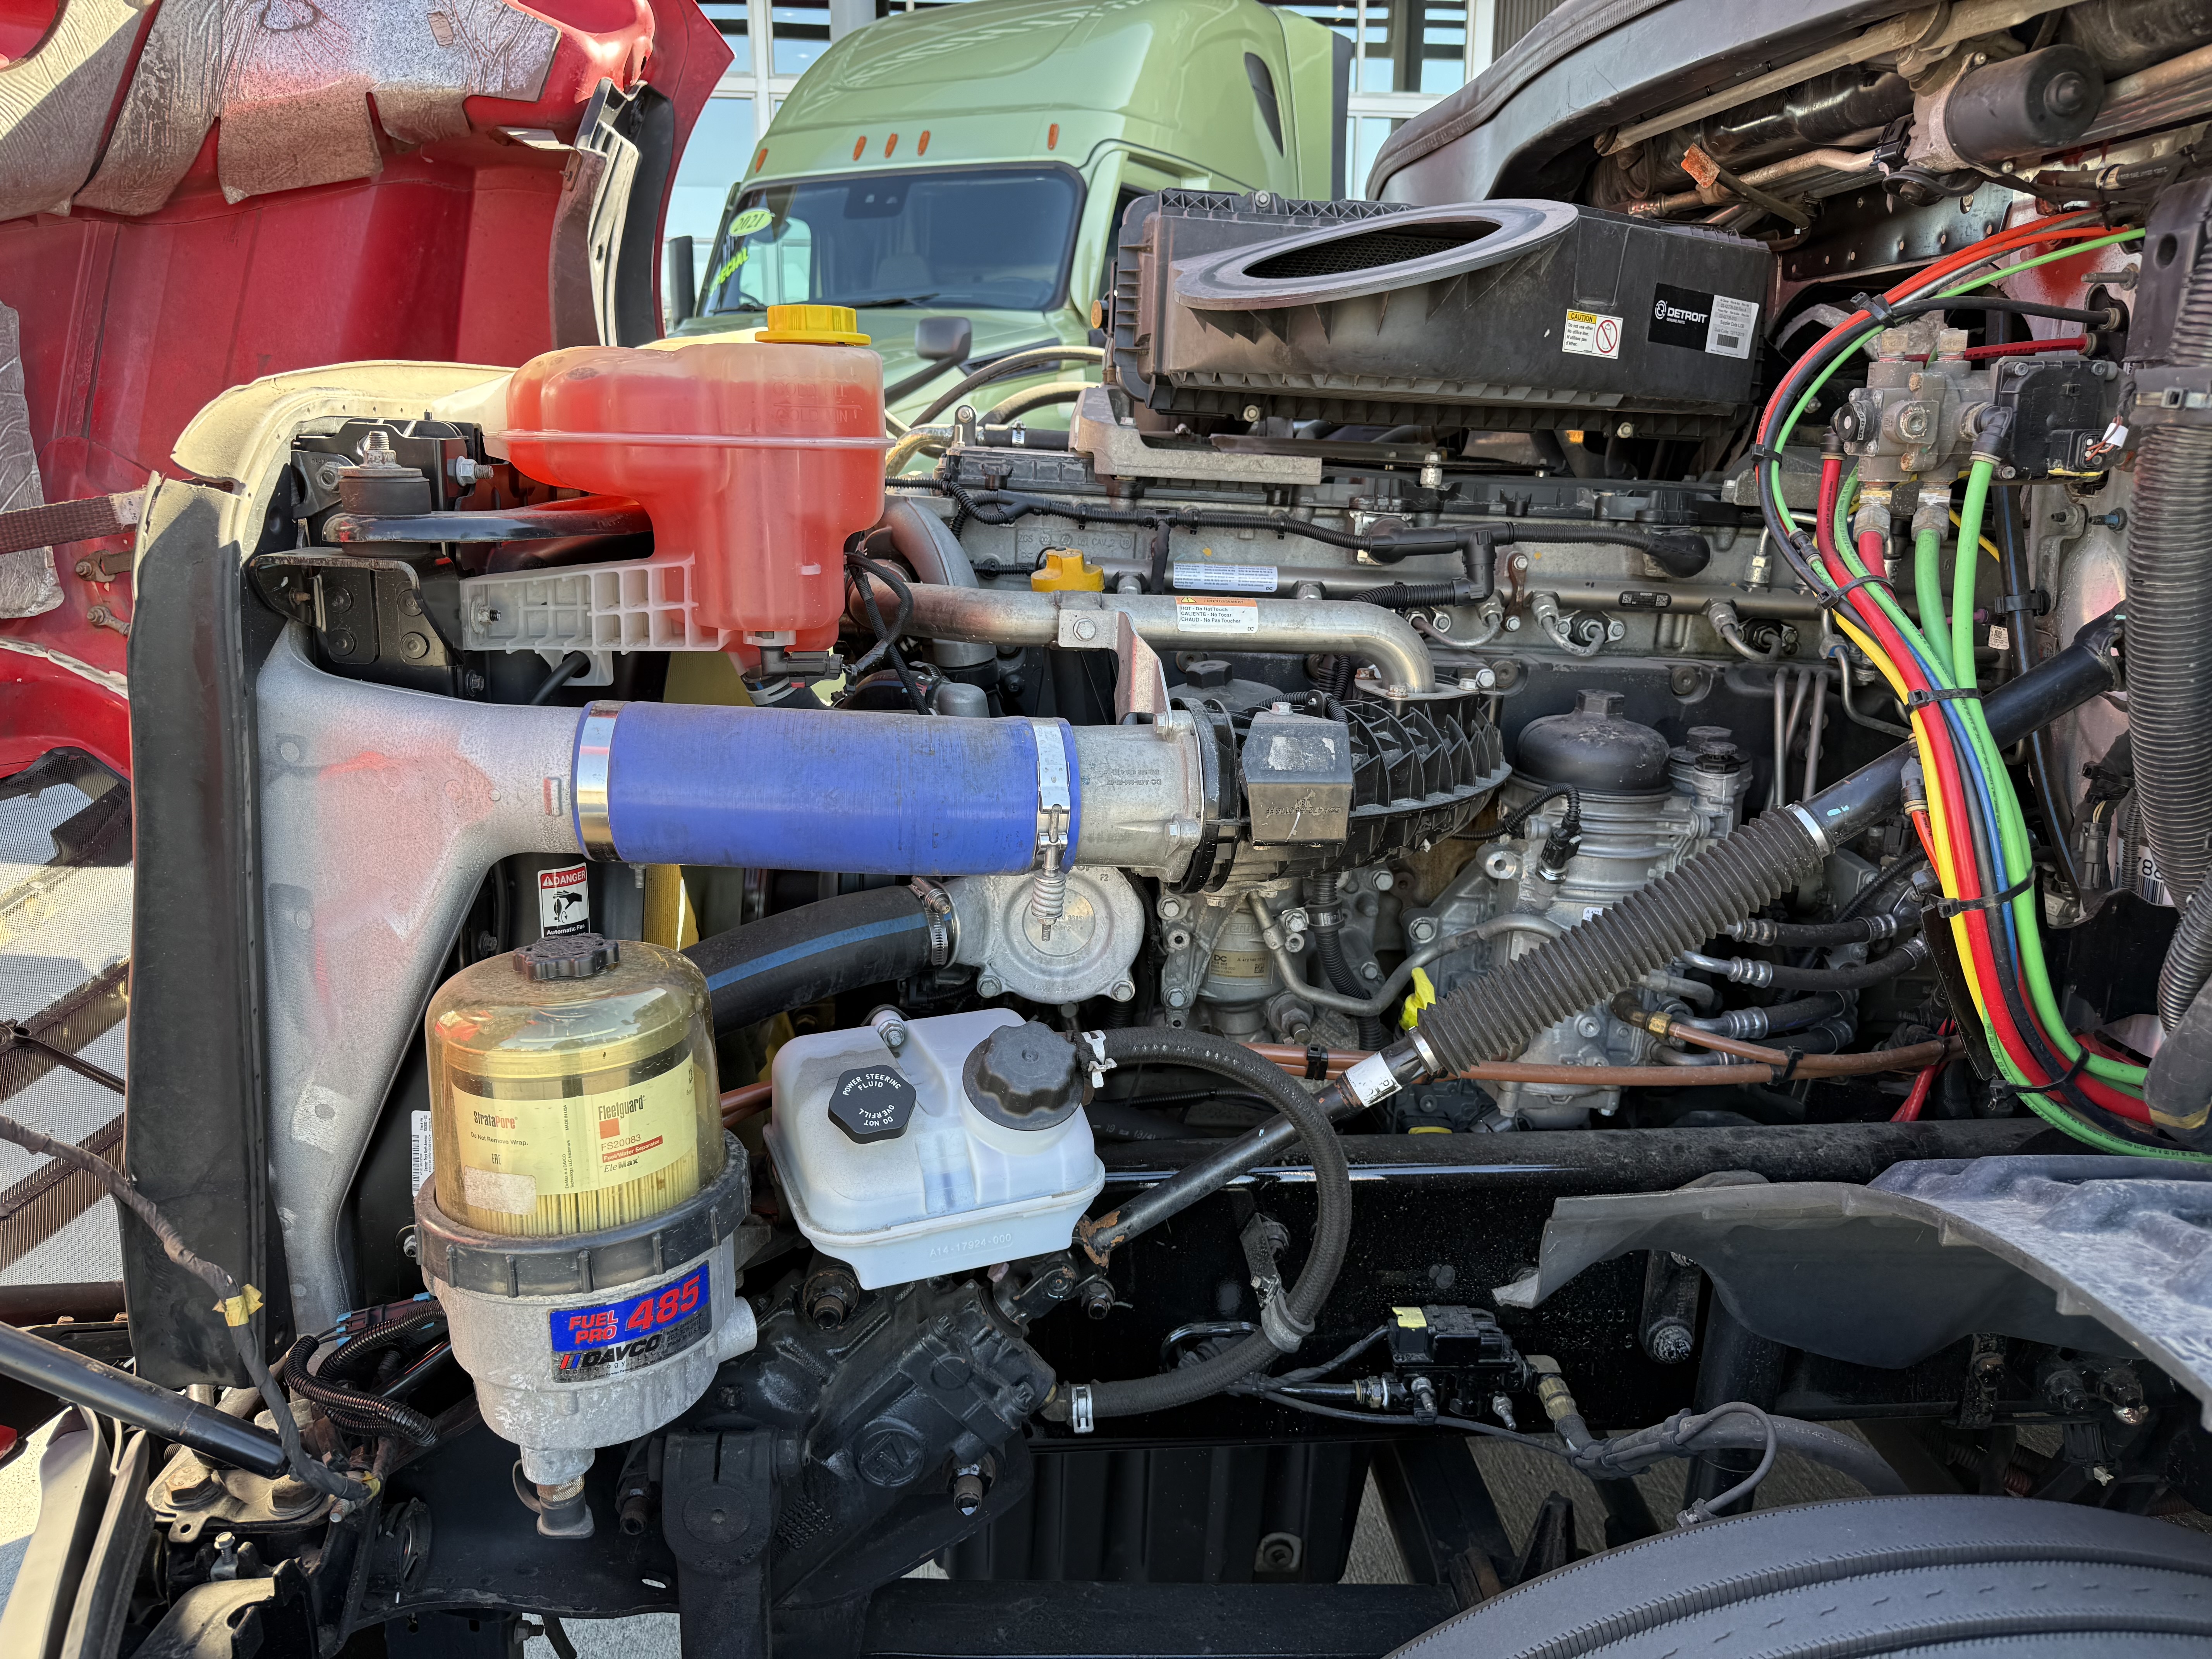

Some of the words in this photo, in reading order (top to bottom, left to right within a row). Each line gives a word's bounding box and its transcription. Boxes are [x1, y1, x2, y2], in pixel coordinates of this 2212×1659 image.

[733, 213, 765, 232] 2021
[1571, 313, 1593, 323] CAUTION
[1667, 307, 1707, 323] DETROIT
[773, 382, 816, 397] COLD
[776, 409, 818, 422] COLD
[555, 870, 586, 885] DANGER
[546, 926, 576, 935] Automatic
[842, 1077, 862, 1096] POWER
[866, 1073, 902, 1089] STEERING
[857, 1081, 883, 1091] FLUID
[598, 1095, 644, 1121] Fleetguard
[859, 1104, 895, 1119] OVERFILL
[474, 1111, 515, 1129] StrataPore
[883, 1116, 894, 1124] DO
[487, 1136, 509, 1144] Remove
[601, 1133, 641, 1151] FS20083
[603, 1149, 634, 1161] Fuel/Water
[635, 1139, 660, 1152] Separator
[930, 1233, 1011, 1257] A14-17924-000
[625, 1274, 700, 1333] 485
[568, 1310, 619, 1331] FUEL
[574, 1324, 617, 1345] PRO
[667, 1338, 680, 1348] Made
[581, 1333, 663, 1367] DAVCO
